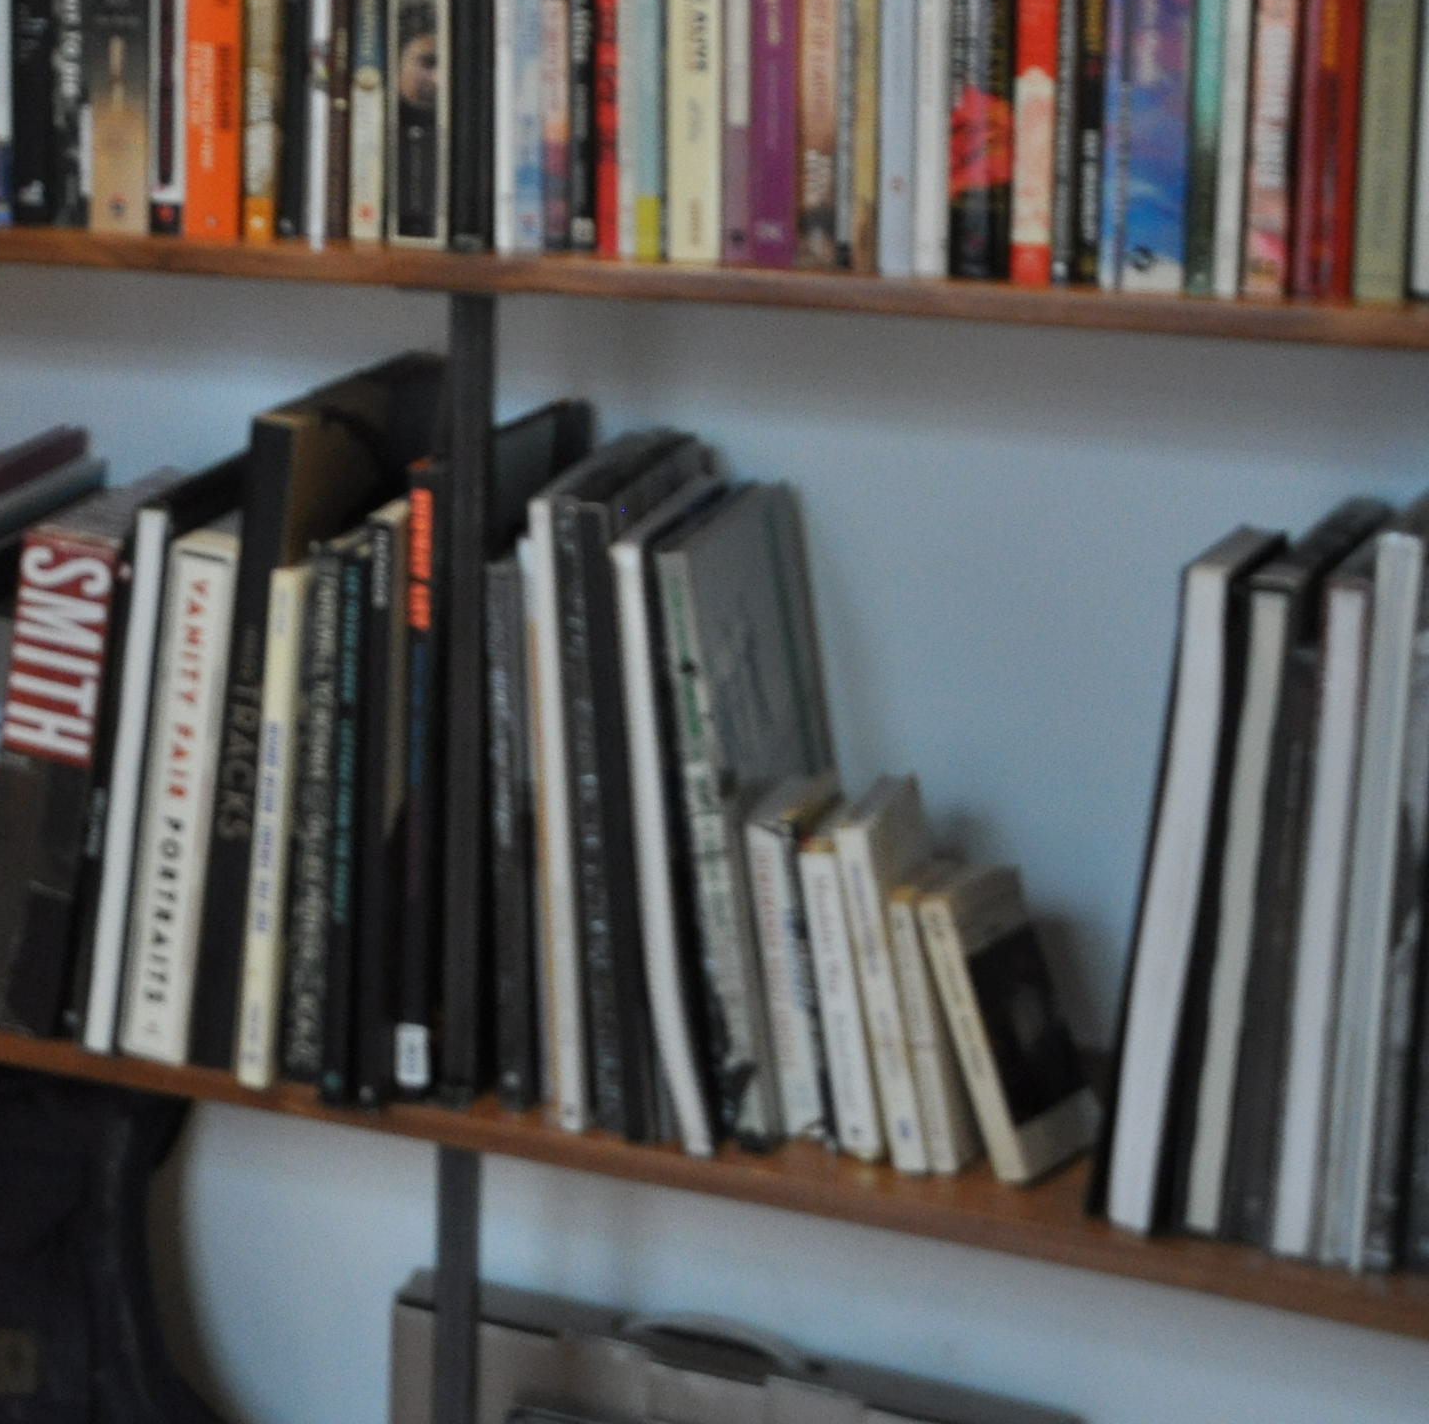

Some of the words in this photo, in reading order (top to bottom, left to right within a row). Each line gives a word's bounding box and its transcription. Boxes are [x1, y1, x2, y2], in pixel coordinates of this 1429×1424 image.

[61, 31, 83, 61] TO
[2, 544, 114, 761] SMITH
[177, 579, 210, 705] VANITY
[166, 725, 196, 799] FAIR
[221, 684, 258, 841] TRACKS
[142, 814, 184, 1007] PORTRAITS
